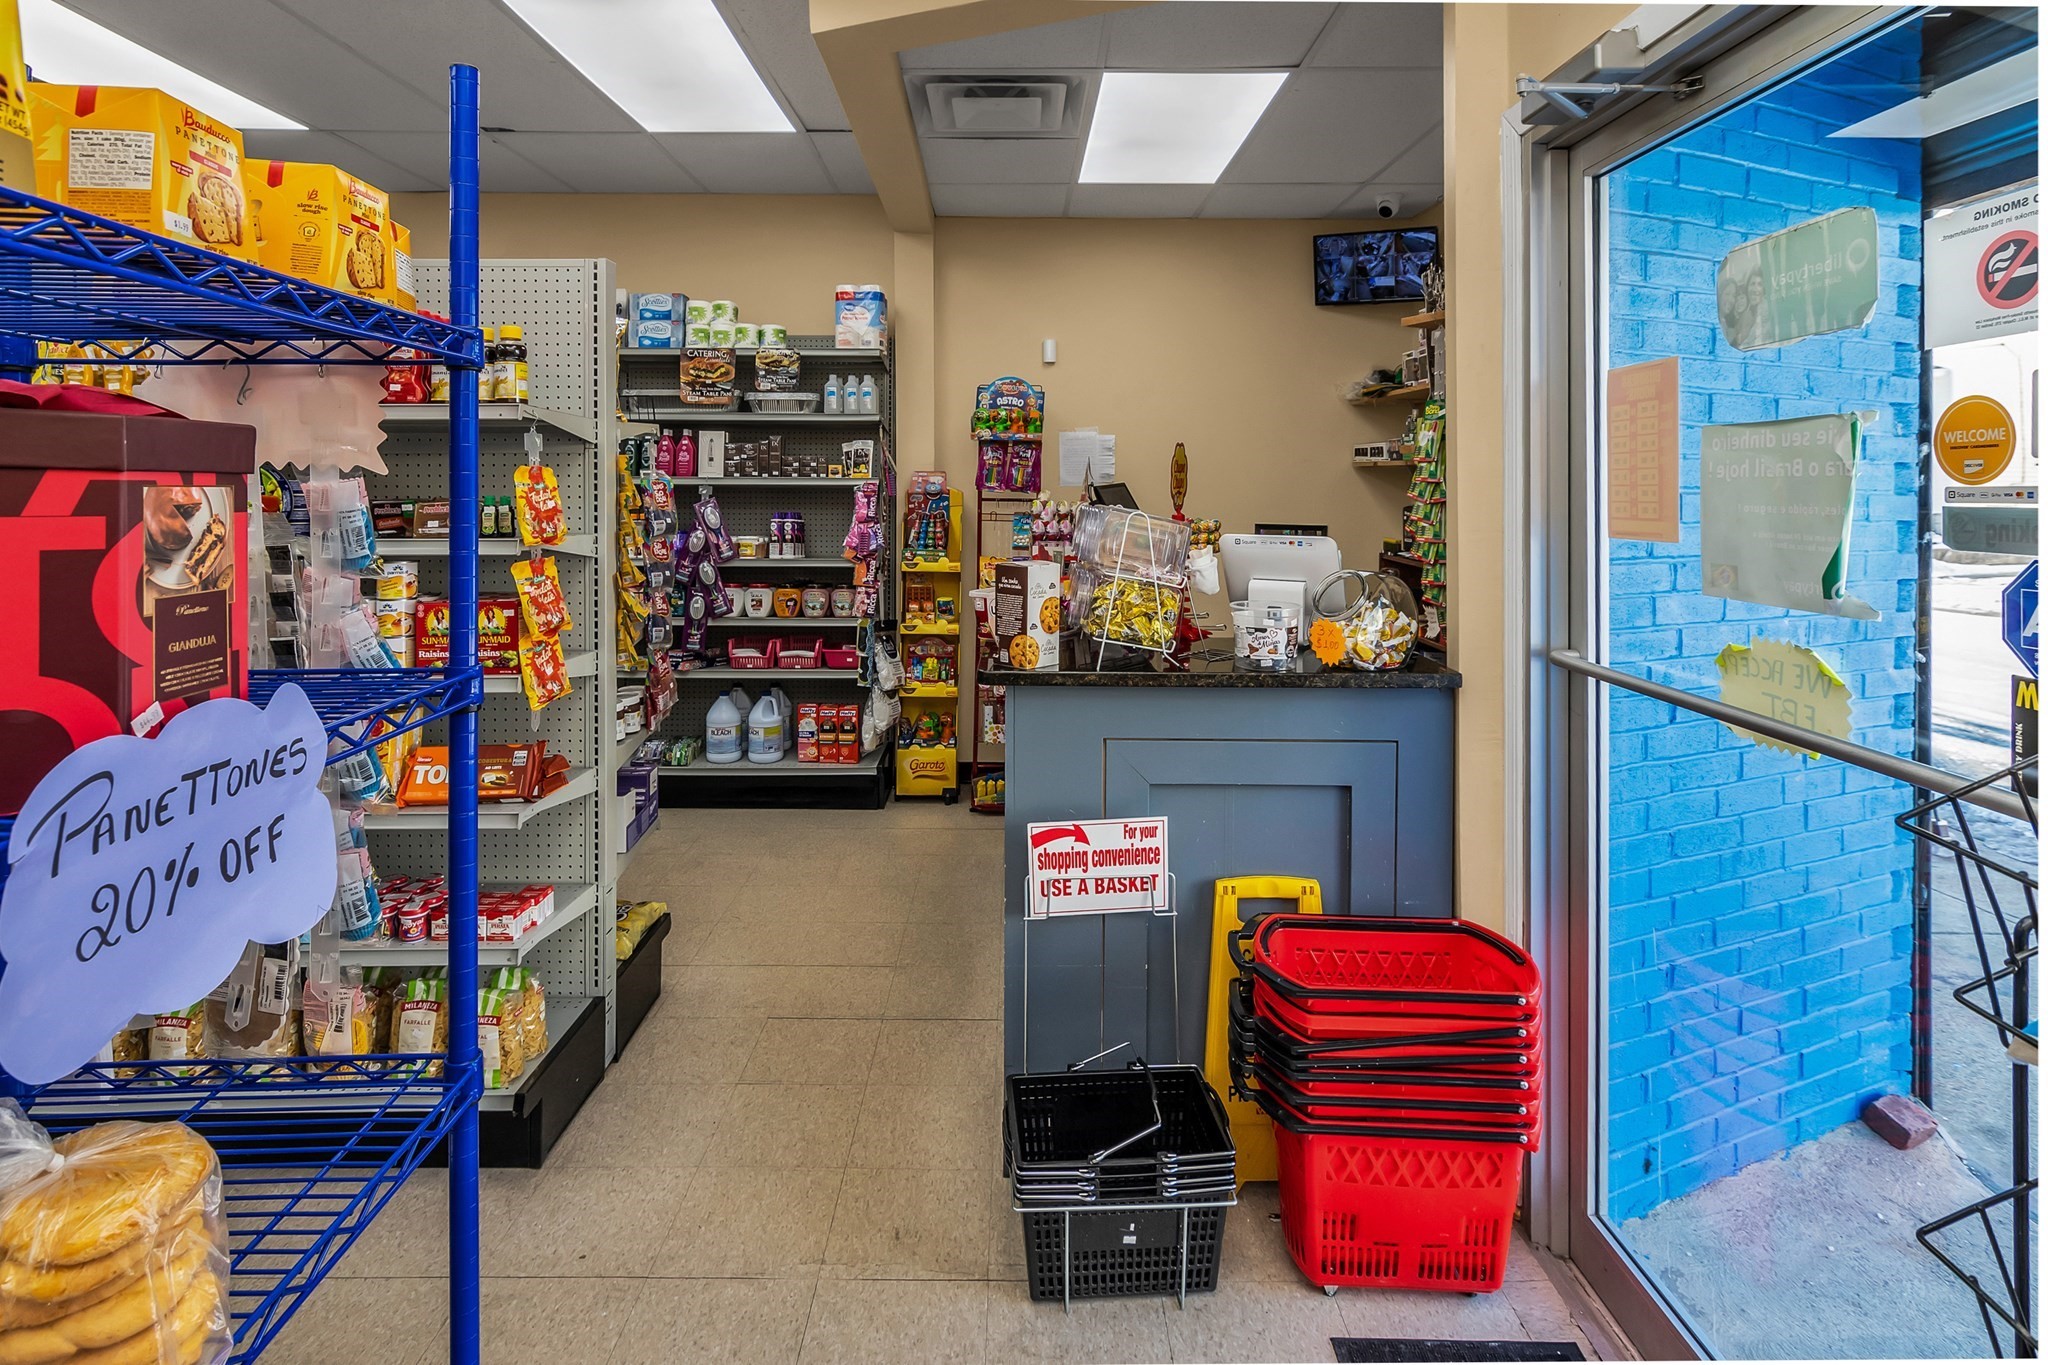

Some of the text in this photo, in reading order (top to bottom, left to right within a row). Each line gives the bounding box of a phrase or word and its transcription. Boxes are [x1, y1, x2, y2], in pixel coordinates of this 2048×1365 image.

[0, 102, 26, 117] ET WT
[180, 107, 231, 144] Bauducco
[175, 126, 241, 165] PANETTONE
[342, 195, 386, 221] PANETTONE
[641, 296, 669, 307] Scotties
[640, 325, 668, 335] Scotties
[686, 350, 727, 358] CATERING
[996, 397, 1024, 407] ASTRO
[1943, 427, 2007, 444] WELCOME
[1317, 625, 1325, 636] 3
[168, 634, 217, 653] GIANDUJA
[421, 637, 449, 645] SUN-MA
[478, 636, 511, 644] UN-MAID
[2016, 722, 2024, 753] DRINK
[909, 758, 946, 772] Garoto
[25, 736, 309, 879] PANETTONES
[1123, 824, 1158, 842] For your
[1037, 843, 1161, 874] shopping convenience
[75, 813, 286, 963] 20% OFF
[1040, 874, 1159, 897] USE A BASKET
[404, 1002, 439, 1011] MILANEZA
[155, 1018, 188, 1028] MILANEZA
[403, 1018, 431, 1026] FARFALLE
